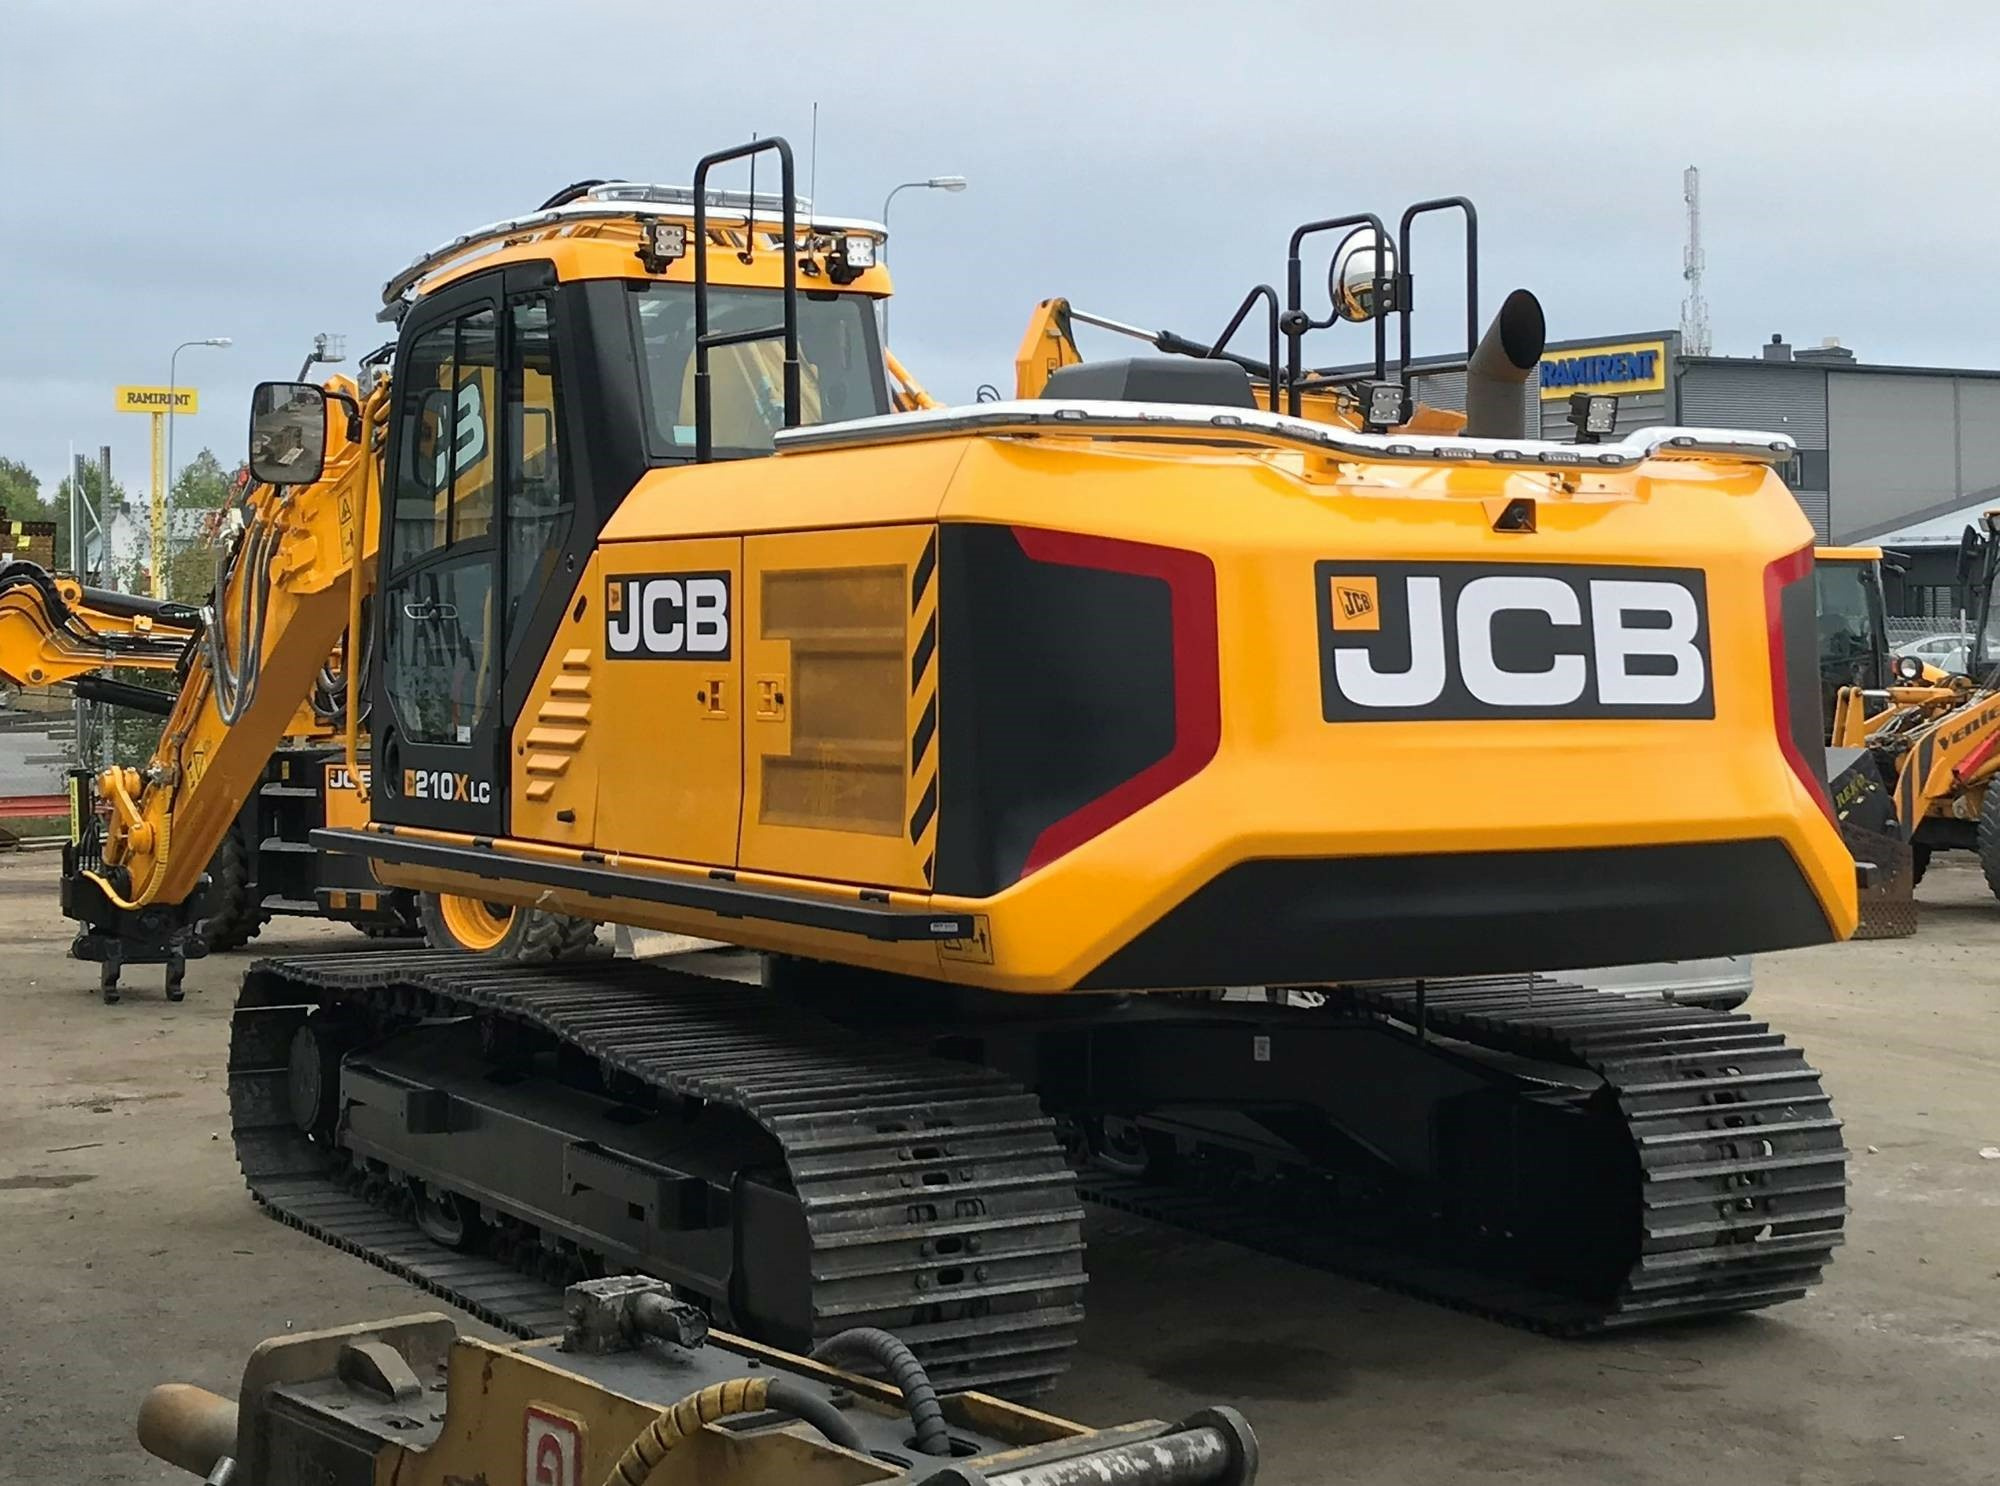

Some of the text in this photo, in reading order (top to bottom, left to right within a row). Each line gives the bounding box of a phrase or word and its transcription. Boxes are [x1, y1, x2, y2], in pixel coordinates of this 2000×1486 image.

[1540, 350, 1659, 388] RAMIRENT
[608, 579, 728, 652] JCB
[1343, 590, 1371, 616] JCB
[1333, 576, 1705, 707] JCB
